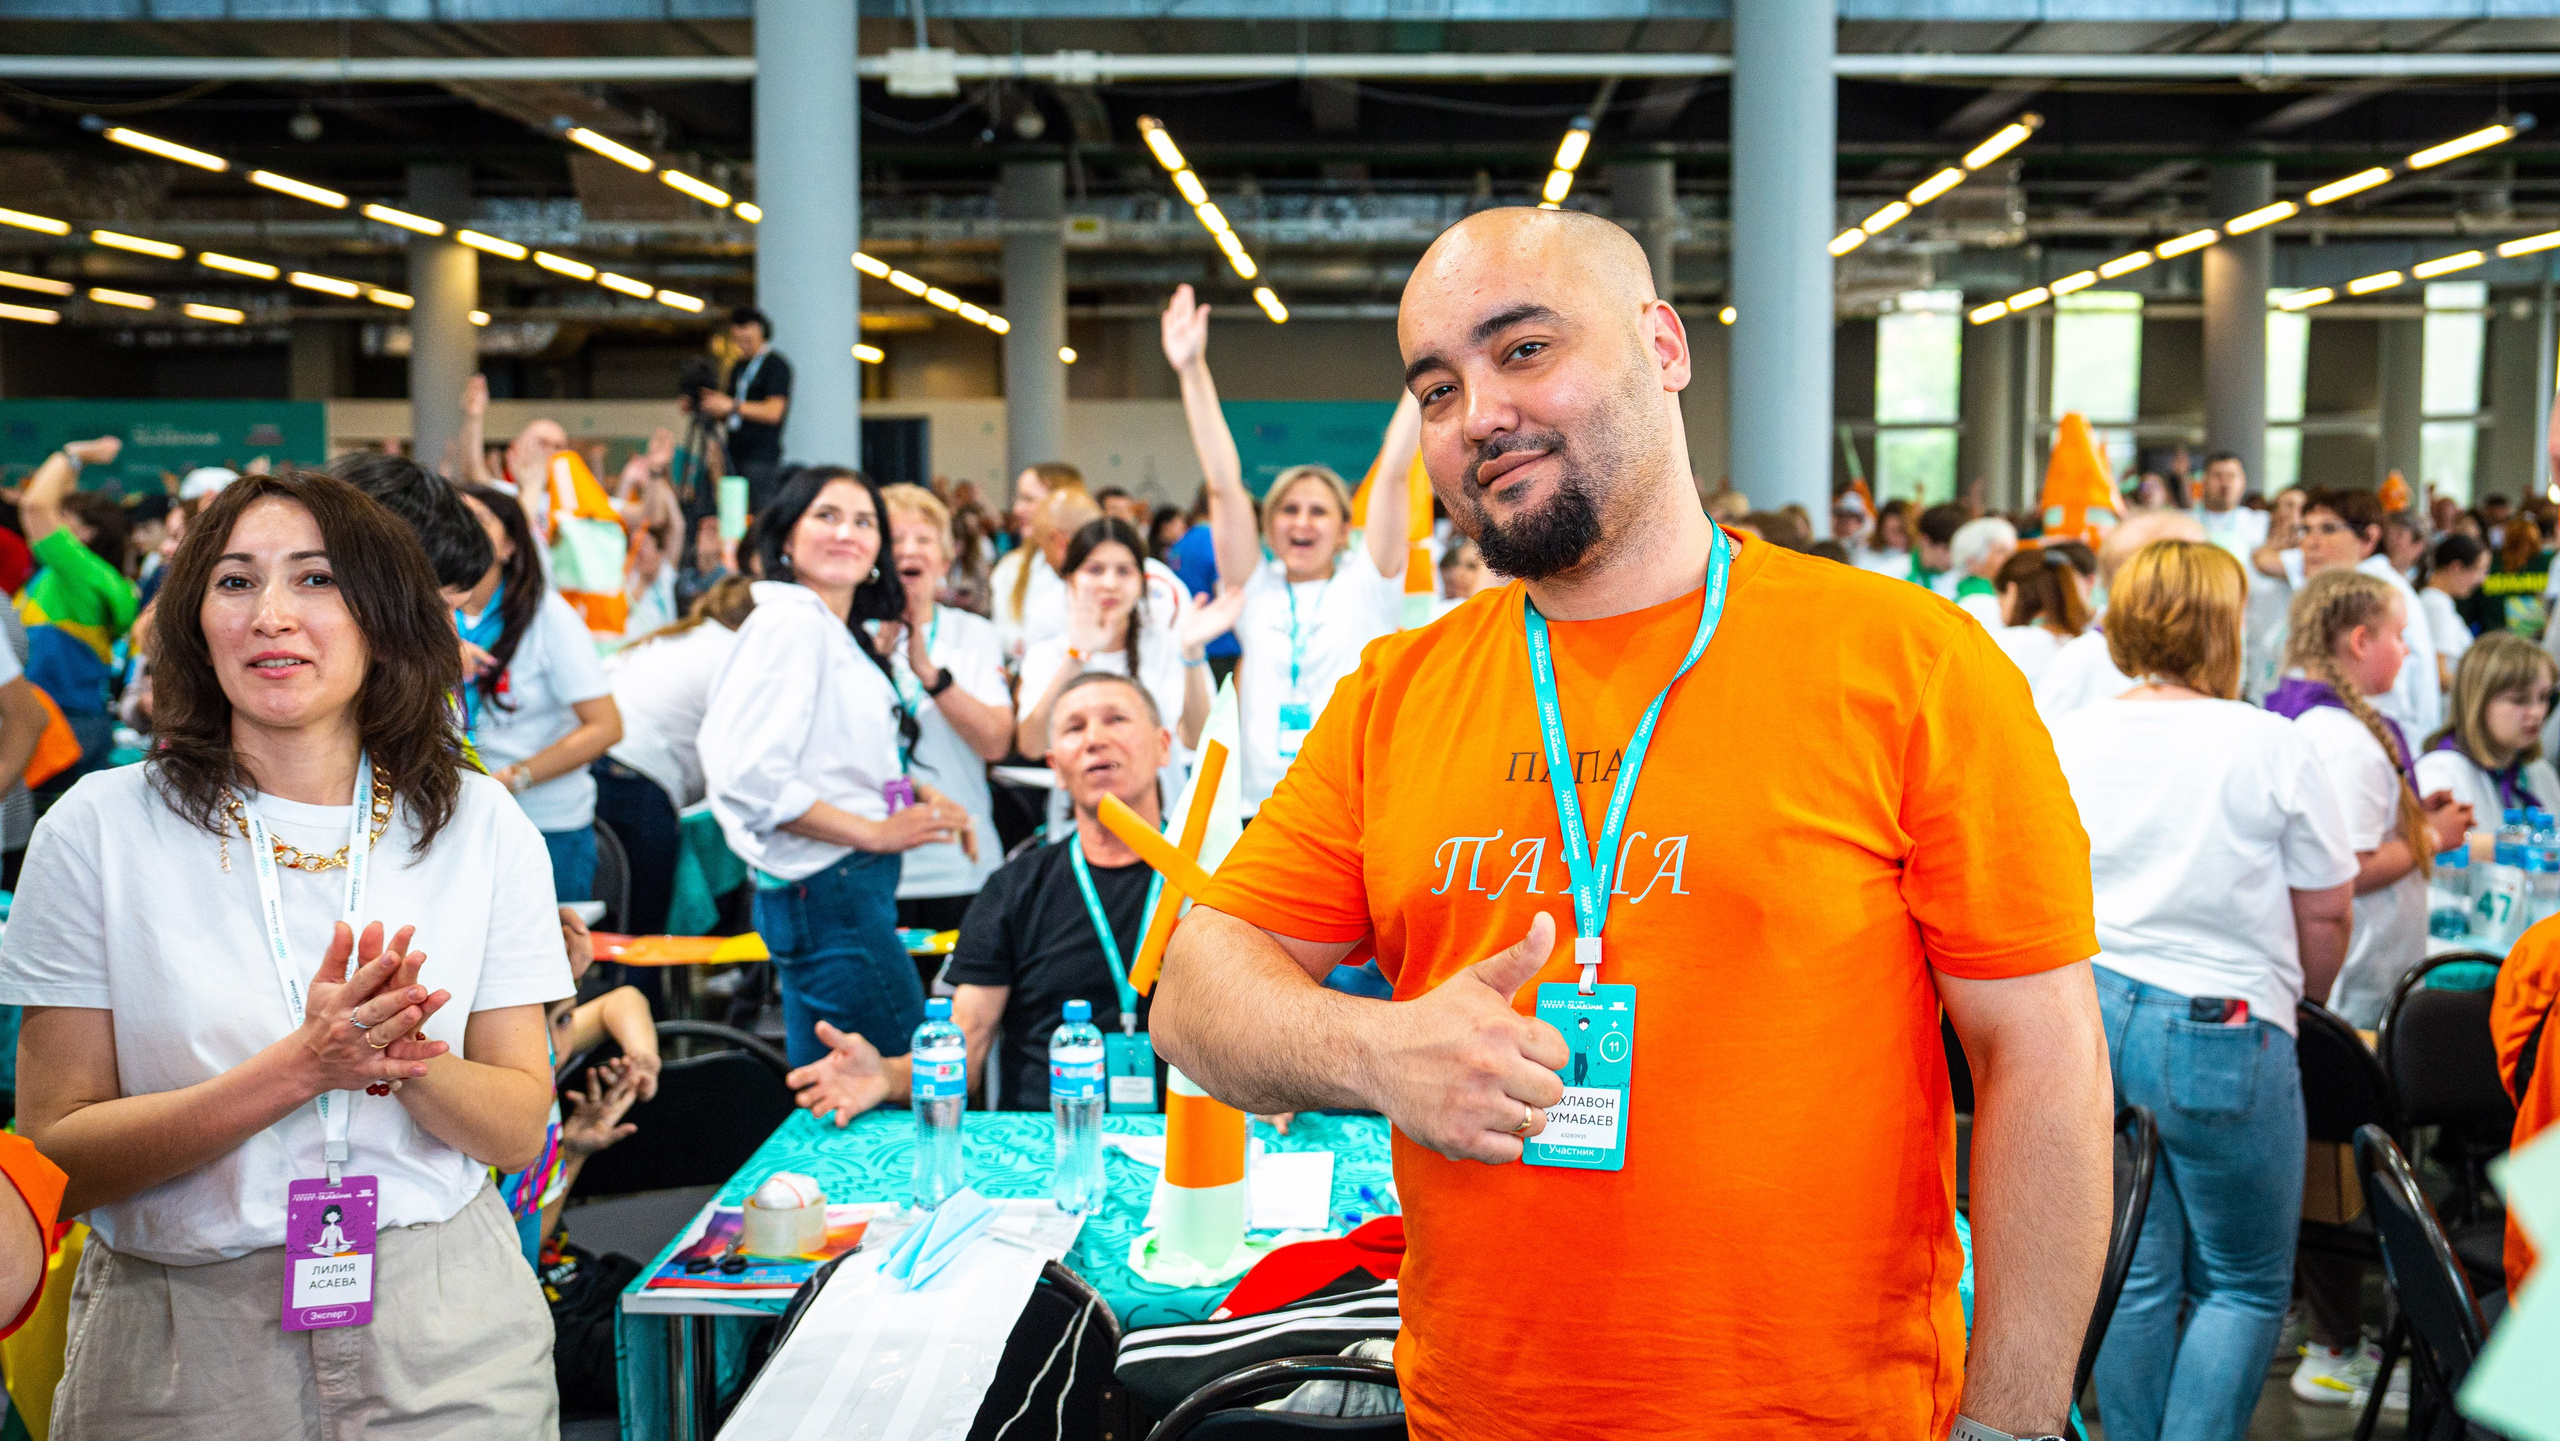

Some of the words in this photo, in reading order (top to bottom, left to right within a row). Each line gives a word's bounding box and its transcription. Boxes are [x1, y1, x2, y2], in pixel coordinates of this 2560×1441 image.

[1505, 748, 1622, 784] ППА
[2477, 889, 2511, 923] 47
[1609, 1041, 1619, 1052] 11
[1557, 1095, 1614, 1109] ХЛАВОН
[1549, 1144, 1594, 1156] Участник
[312, 1263, 355, 1275] ЛИЛИЯ
[309, 1277, 357, 1289] АСАЕВА
[310, 1311, 348, 1320] Эксперт
